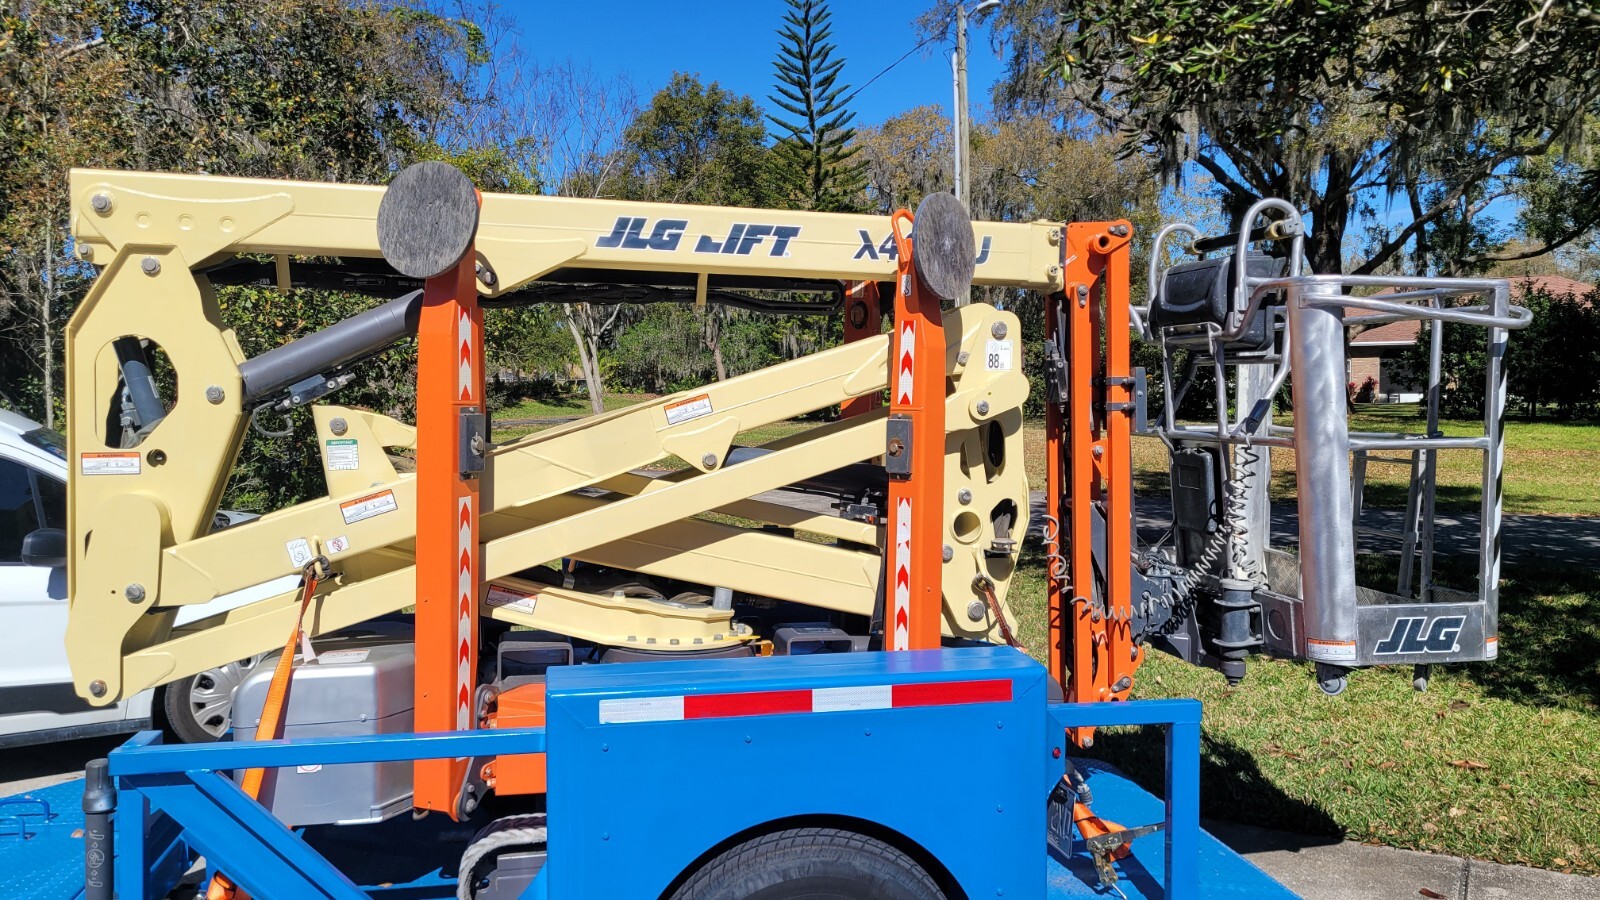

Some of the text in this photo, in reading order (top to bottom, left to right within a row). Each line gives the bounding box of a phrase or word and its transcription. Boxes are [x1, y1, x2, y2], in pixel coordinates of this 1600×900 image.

[595, 216, 688, 251] JLG
[988, 353, 999, 368] 88
[1373, 615, 1466, 655] JLG
